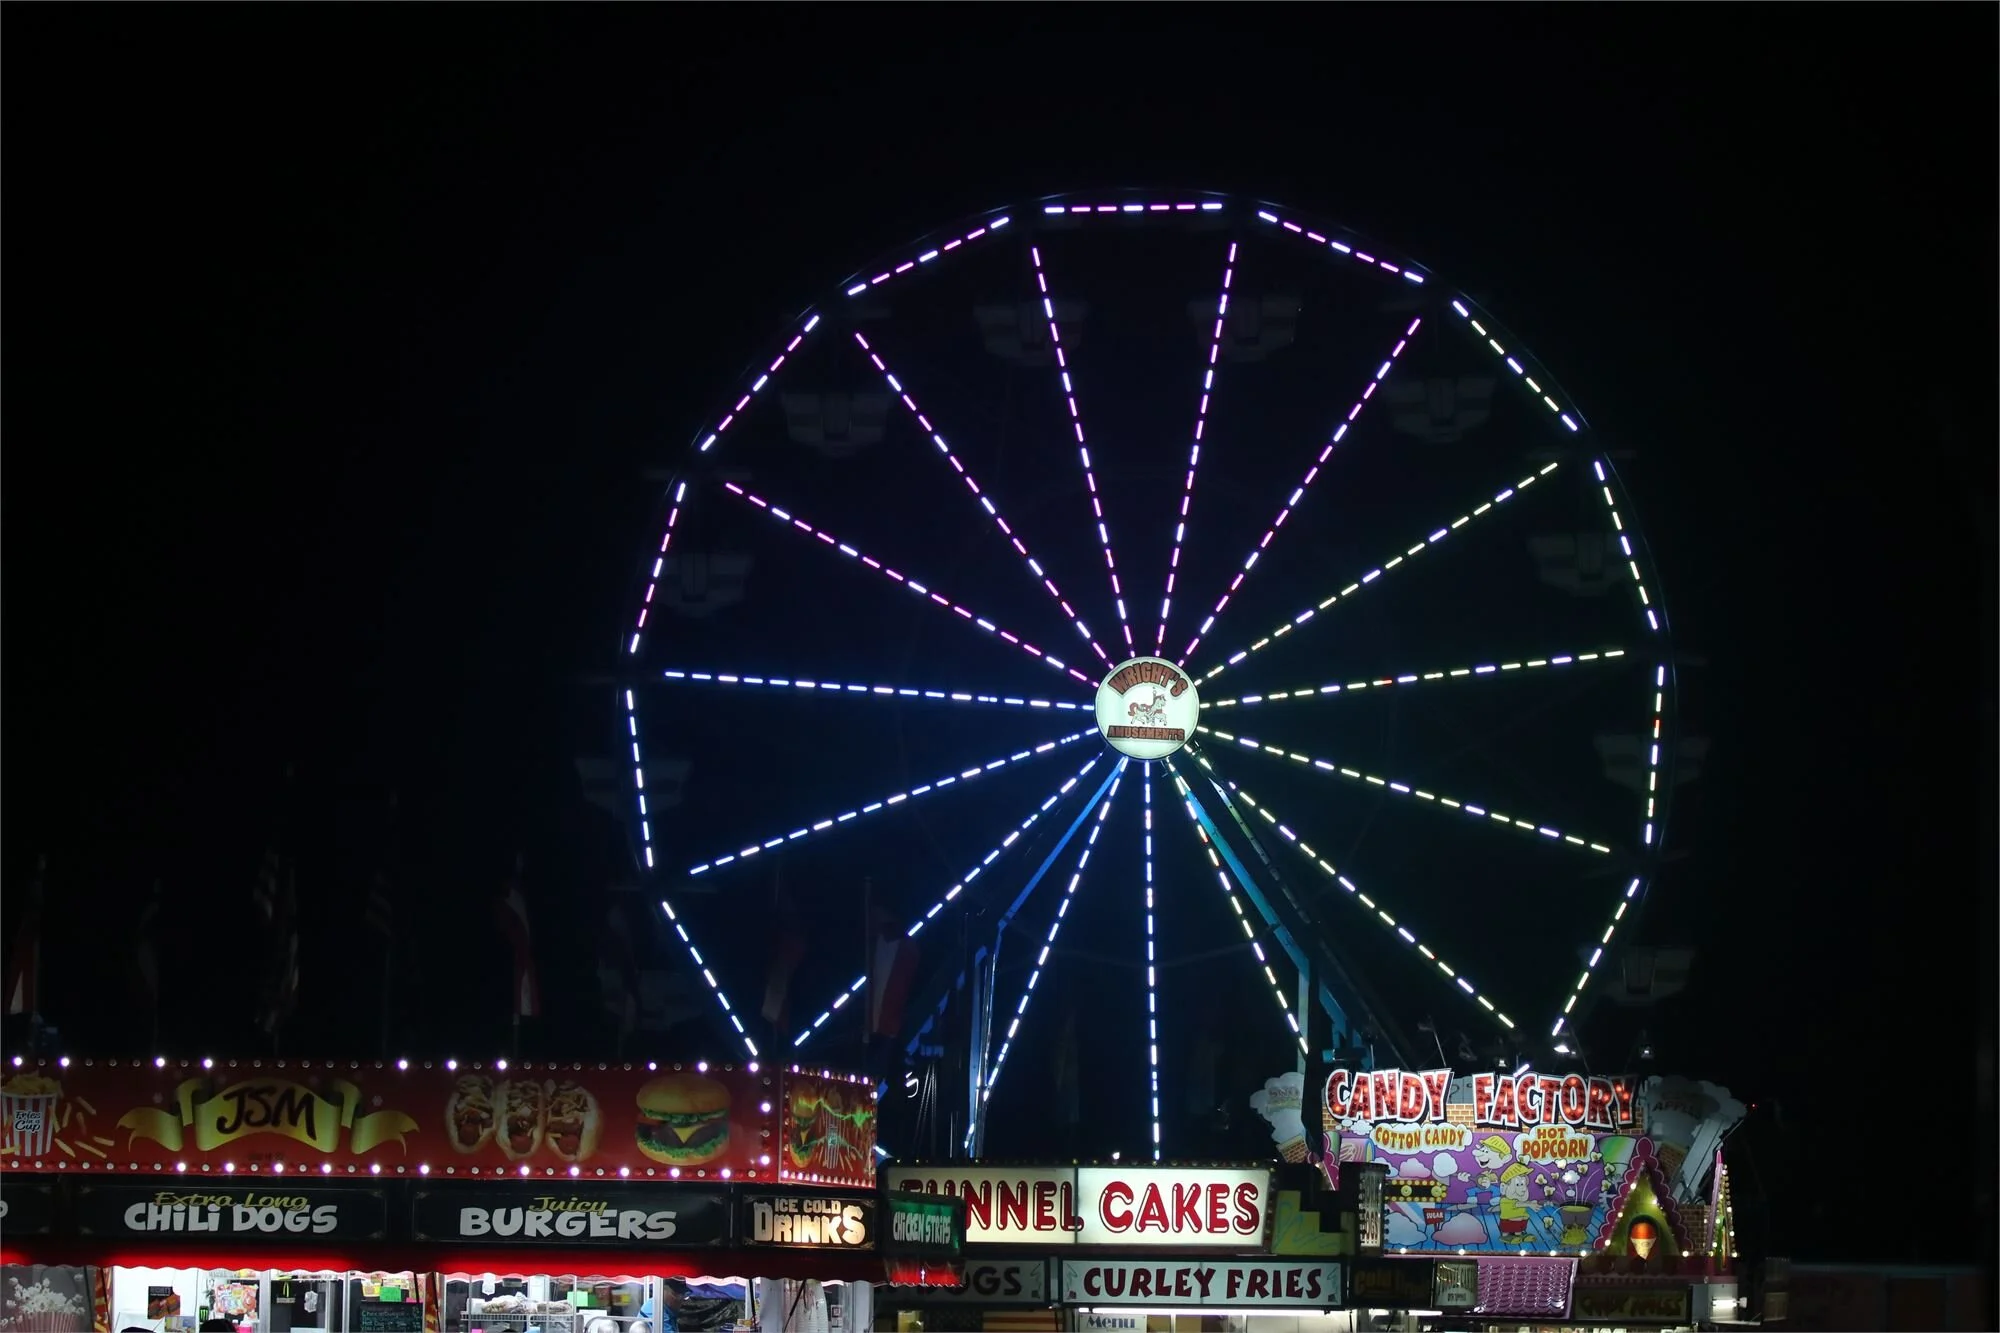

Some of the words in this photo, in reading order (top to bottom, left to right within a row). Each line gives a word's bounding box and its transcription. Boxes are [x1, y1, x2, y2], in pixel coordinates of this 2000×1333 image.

[1107, 661, 1189, 698] WRIGHT'S
[1106, 724, 1186, 742] AMUSEMENTS
[1325, 1067, 1454, 1124] CANDY
[1471, 1070, 1640, 1130] FACTORY
[15, 1110, 41, 1120] Fries
[216, 1085, 317, 1140] JSM
[15, 1120, 41, 1132] Cup
[1374, 1127, 1422, 1151] COTTON
[1425, 1124, 1467, 1150] CANDY
[1535, 1126, 1567, 1139] HOT
[1521, 1136, 1589, 1160] POPCORN
[153, 1191, 235, 1208] Extra
[241, 1192, 309, 1211] Long
[528, 1196, 608, 1216] Juicy
[775, 1198, 800, 1214] ICE
[803, 1199, 841, 1215] COLD
[1099, 1180, 1261, 1235] CAKES
[232, 1203, 339, 1234] DOGS
[459, 1206, 677, 1240] BURGERS
[754, 1201, 866, 1246] DRINKS
[1083, 1267, 1217, 1299] CURLEY
[1226, 1268, 1323, 1300] FRIES
[1086, 1315, 1136, 1329] Menu
